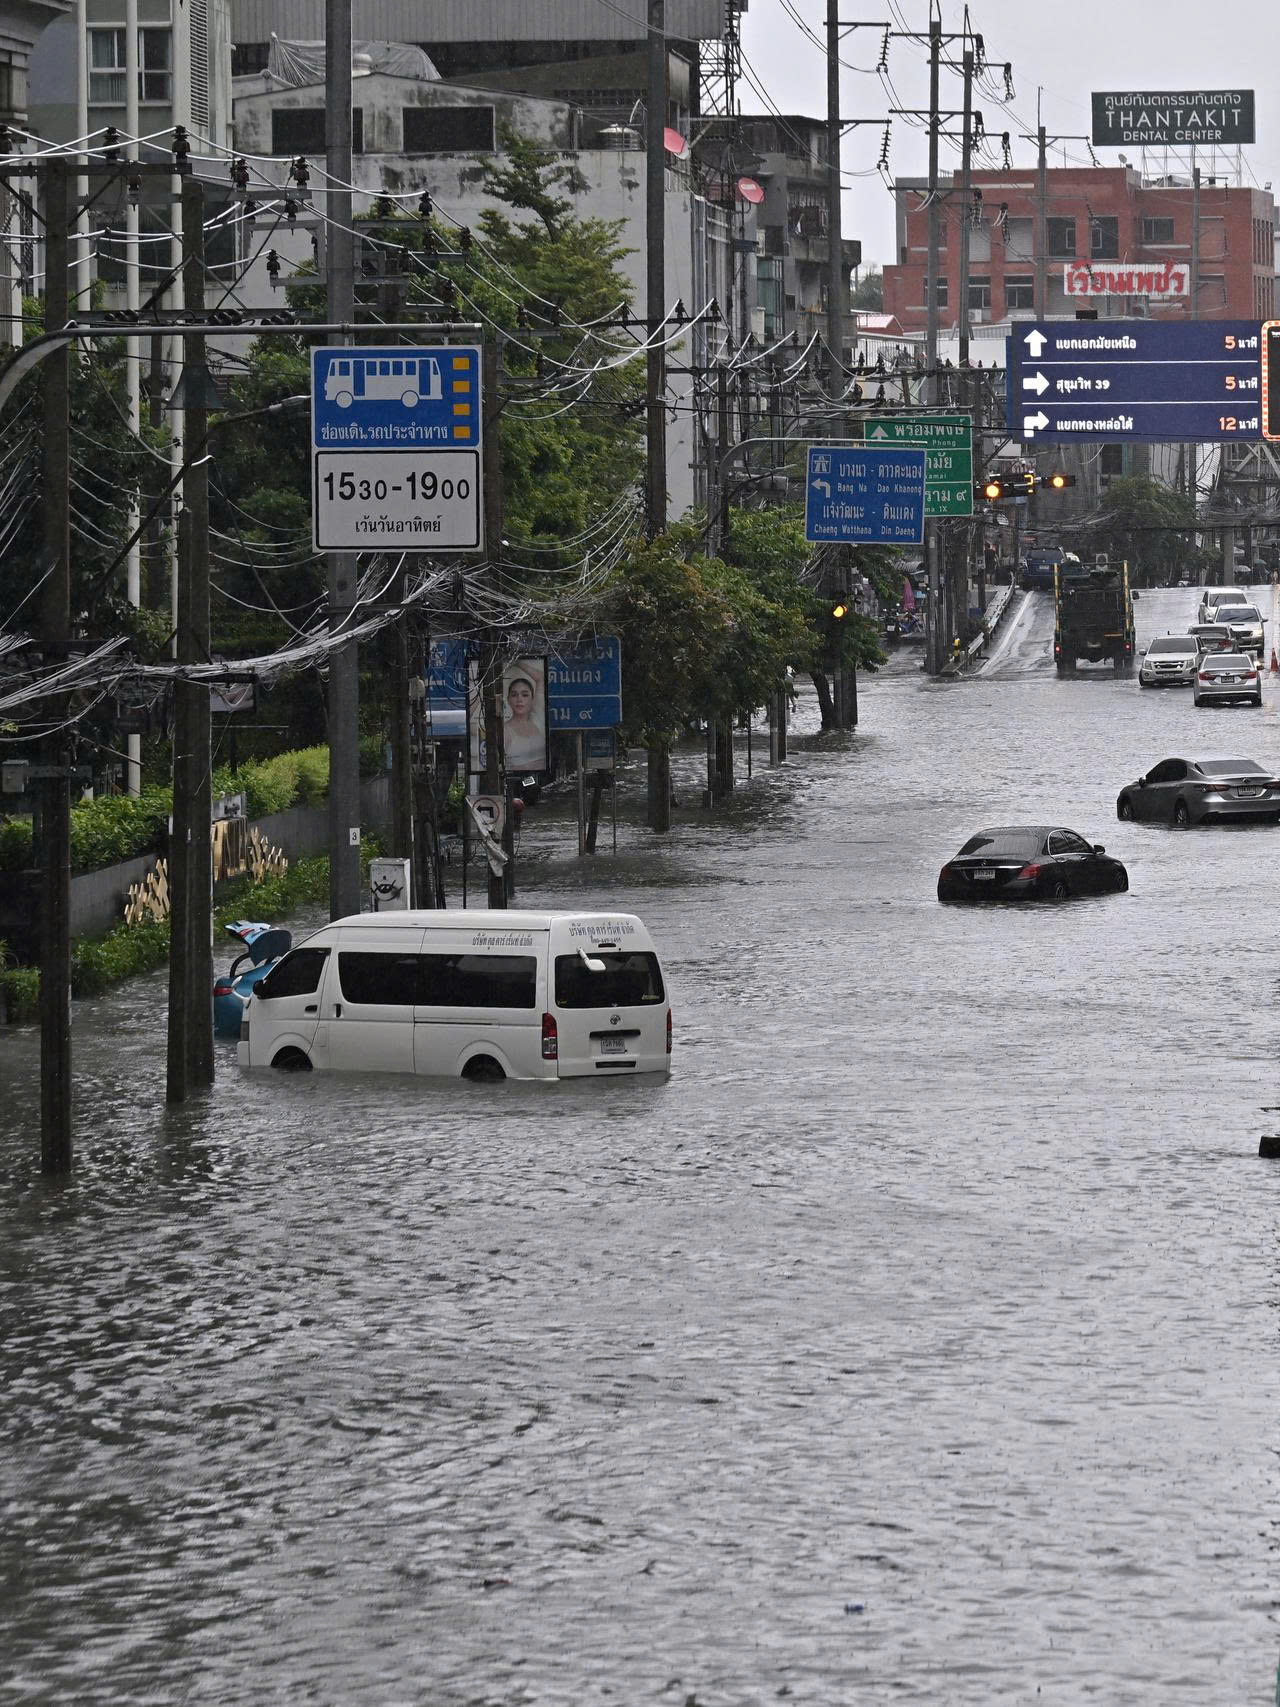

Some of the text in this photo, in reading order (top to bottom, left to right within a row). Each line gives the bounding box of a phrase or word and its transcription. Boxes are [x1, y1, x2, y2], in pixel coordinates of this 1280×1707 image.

[1105, 93, 1241, 110] ศูนย์ทันตกรรมทันตกิจ
[1105, 109, 1241, 128] THANTAKIT
[1123, 130, 1222, 141] DENTAL CENTER
[1056, 336, 1258, 349] แยกเอกมัยเหนือ 5 นาที
[1056, 377, 1258, 393] สุขุมวิท 39 5 นาที
[321, 422, 448, 439] ช่องเดินรถประจำทาง
[1057, 416, 1258, 430] แยกทองหล่อใต้ 12 นาที
[839, 464, 866, 477] บางนา
[878, 465, 922, 479] ดาวคะนอง
[837, 483, 922, 496] Bang Na Dao Khanong
[823, 501, 865, 519] แจ้งวัฒนะ
[883, 502, 914, 520] ดินแดง
[356, 515, 442, 532] เว้นวันอาทิตย์
[814, 524, 915, 538] Chaeng Watthana Din Daeng
[351, 831, 358, 842] 3
